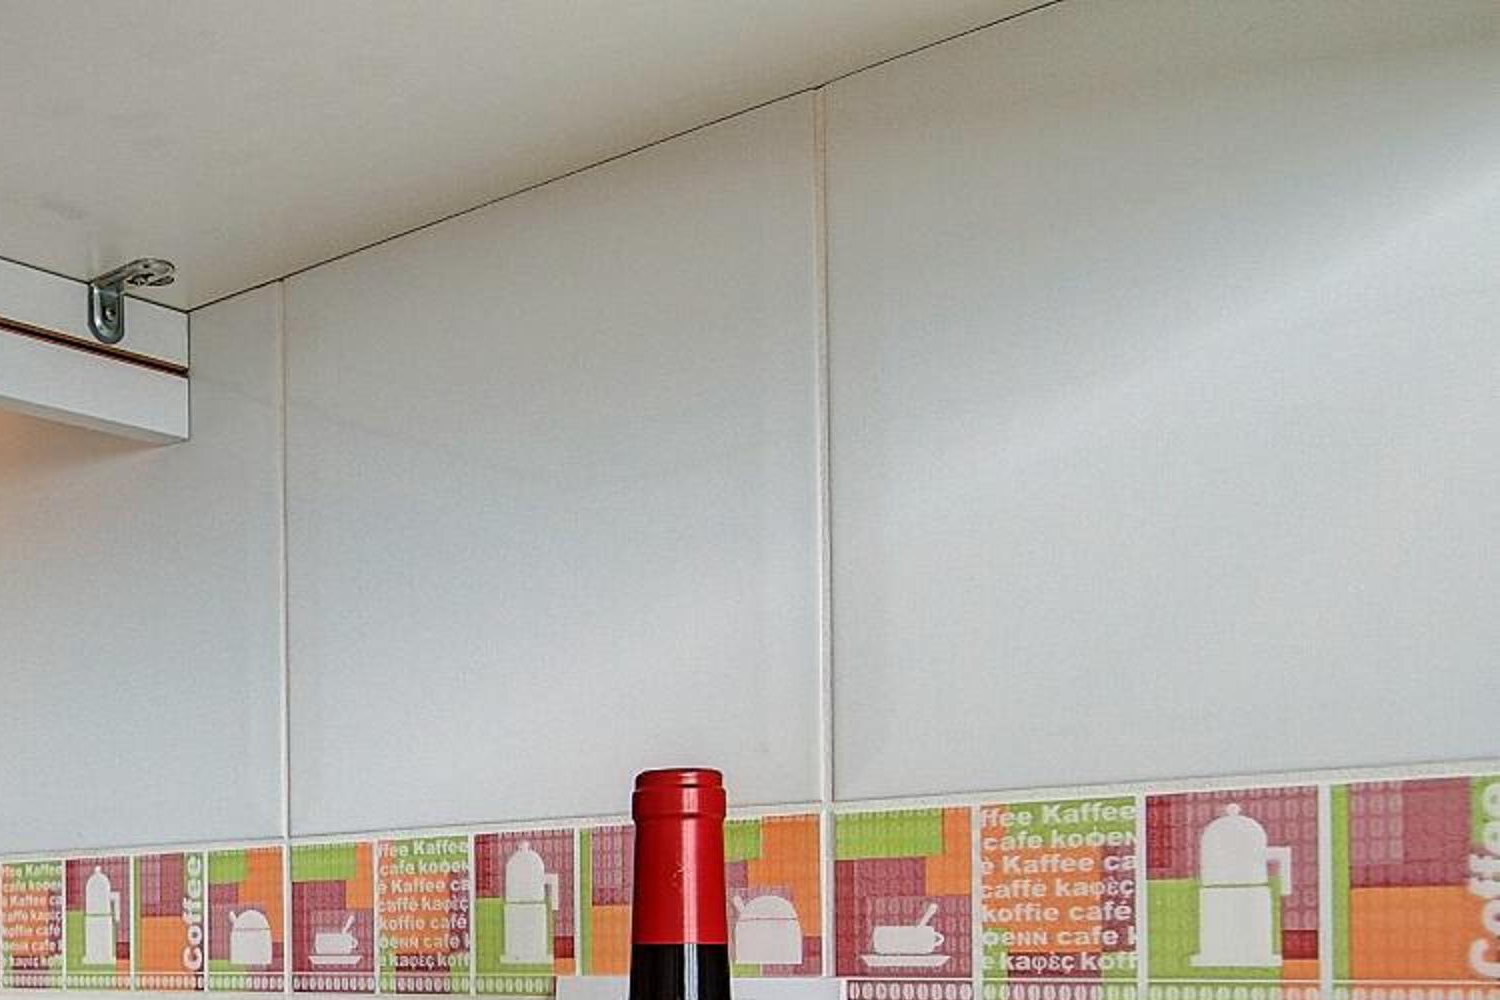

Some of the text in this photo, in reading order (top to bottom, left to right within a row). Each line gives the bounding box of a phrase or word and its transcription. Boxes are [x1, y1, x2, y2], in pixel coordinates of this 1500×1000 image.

[1043, 801, 1136, 824] Kaffee
[413, 839, 468, 854] Kaffee
[983, 831, 1043, 850] cafe
[380, 860, 415, 876] cafe
[1002, 853, 1095, 875] Kaffee
[1103, 855, 1137, 871] ca
[391, 878, 445, 893] Kaffee
[981, 878, 1047, 899] caffè
[182, 855, 202, 970] Coffee
[981, 901, 1132, 923] koffie café
[424, 932, 460, 948] cafe
[1057, 926, 1119, 945] cafe
